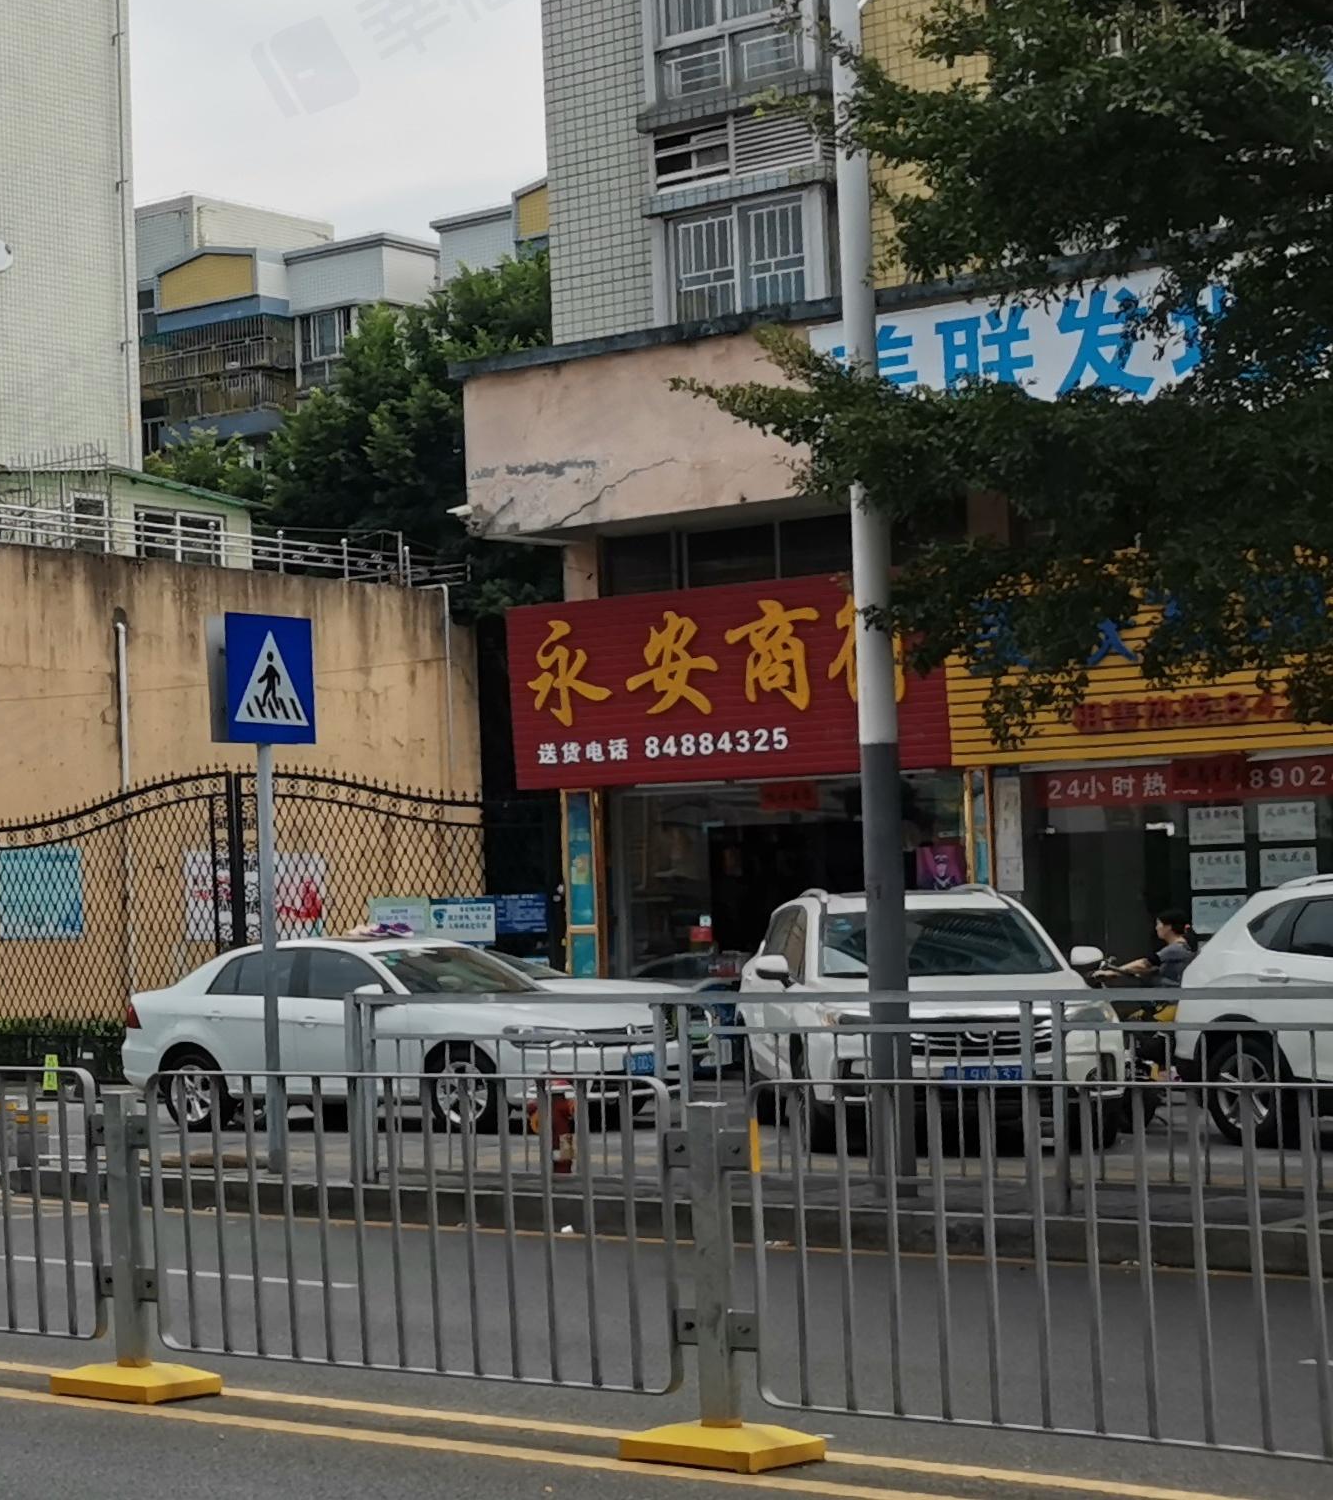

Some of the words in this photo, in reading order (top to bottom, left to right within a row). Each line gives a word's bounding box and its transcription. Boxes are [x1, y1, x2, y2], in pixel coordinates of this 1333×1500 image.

[537, 738, 629, 765] 送货电话
[644, 727, 789, 760] 84884325
[1048, 770, 1199, 800] 24小时热
